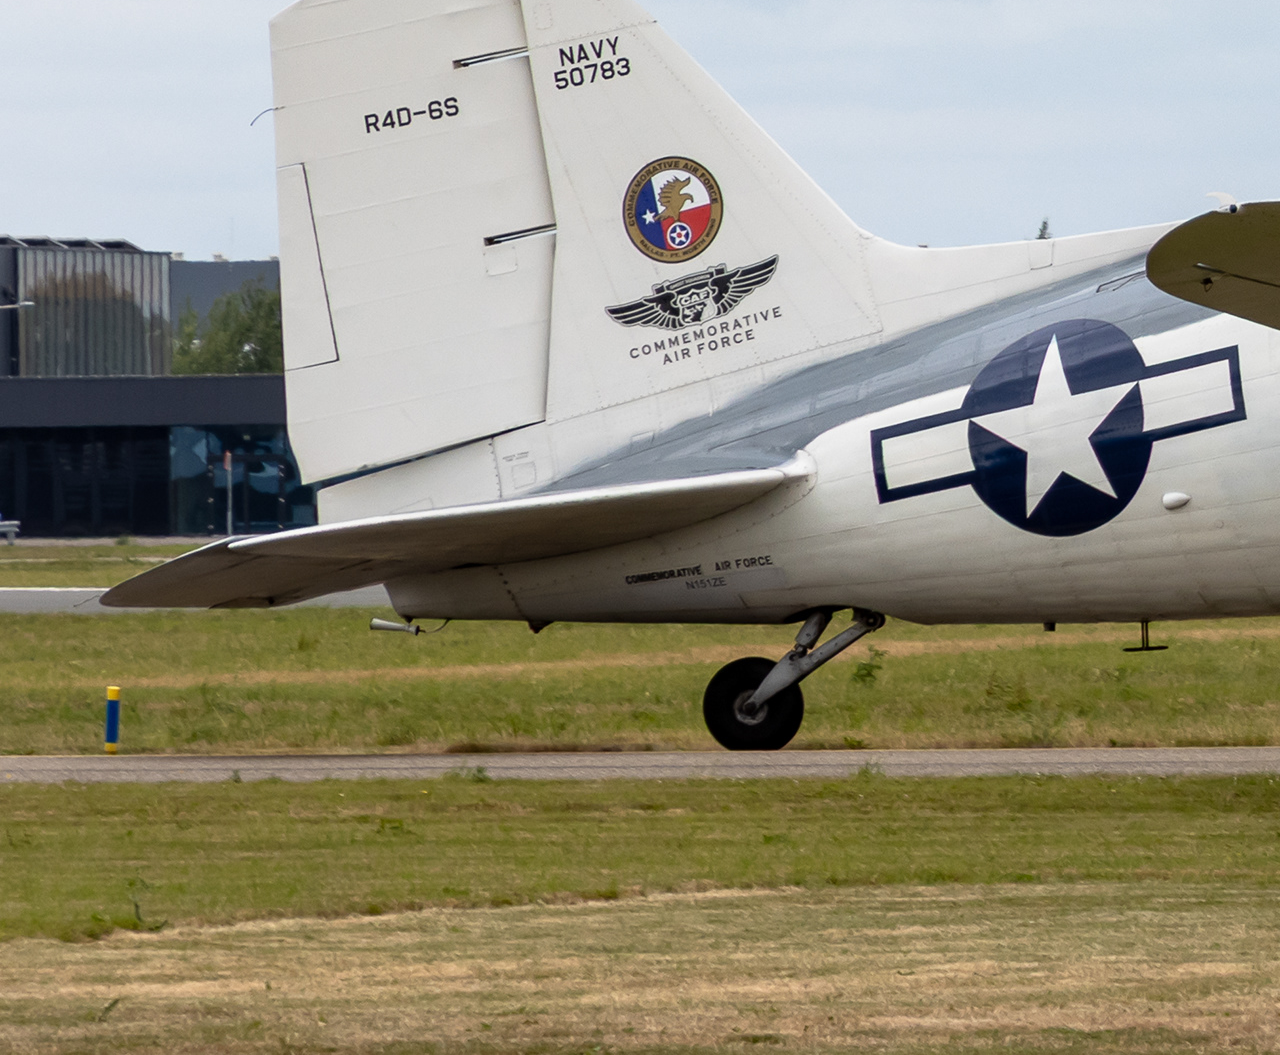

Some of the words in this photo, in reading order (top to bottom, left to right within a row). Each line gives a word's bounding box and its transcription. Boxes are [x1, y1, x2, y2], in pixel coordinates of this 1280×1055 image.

[558, 36, 619, 66] NAVY
[554, 57, 631, 90] 50783
[364, 97, 459, 133] R4D-6S
[626, 160, 681, 227] COMMEMORATIVE
[682, 162, 700, 175] AIR
[699, 172, 719, 204] FORCE
[680, 290, 708, 305] CAF
[629, 306, 783, 359] COMMEMORATIVE
[663, 348, 692, 365] AIR
[697, 329, 756, 355] FORCE
[625, 564, 702, 585] COMMEMORATIVE
[715, 560, 732, 571] AIR
[735, 555, 773, 569] FORCE
